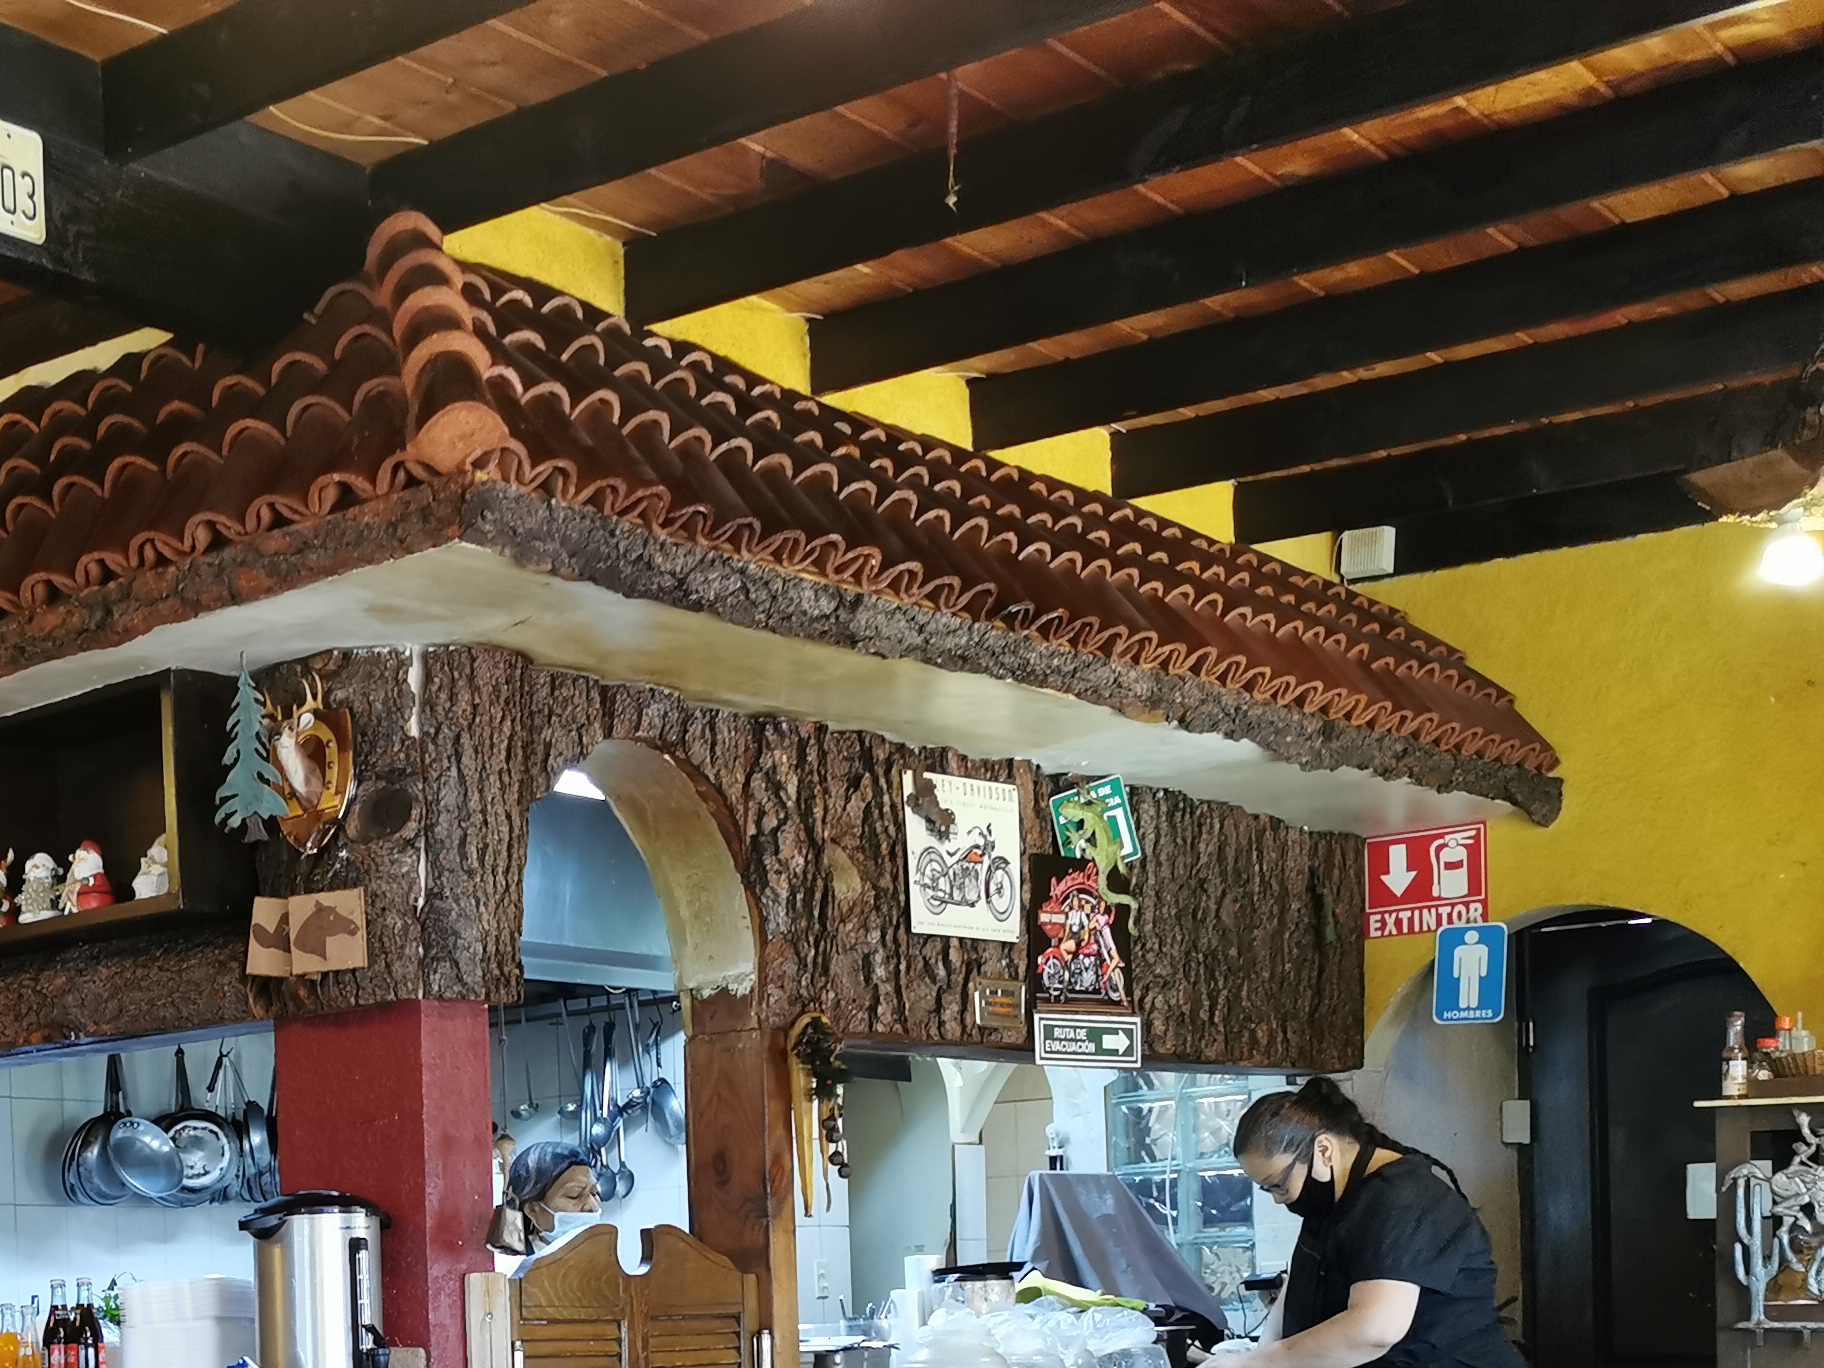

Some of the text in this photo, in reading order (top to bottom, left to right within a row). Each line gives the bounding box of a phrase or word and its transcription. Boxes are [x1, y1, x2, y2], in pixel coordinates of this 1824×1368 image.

[1369, 902, 1483, 937] EXTINTOR
[1443, 1009, 1493, 1019] HOMBRES
[1053, 1027, 1087, 1039] RUTA DE
[1045, 1039, 1095, 1053] EVACUACIÓN
